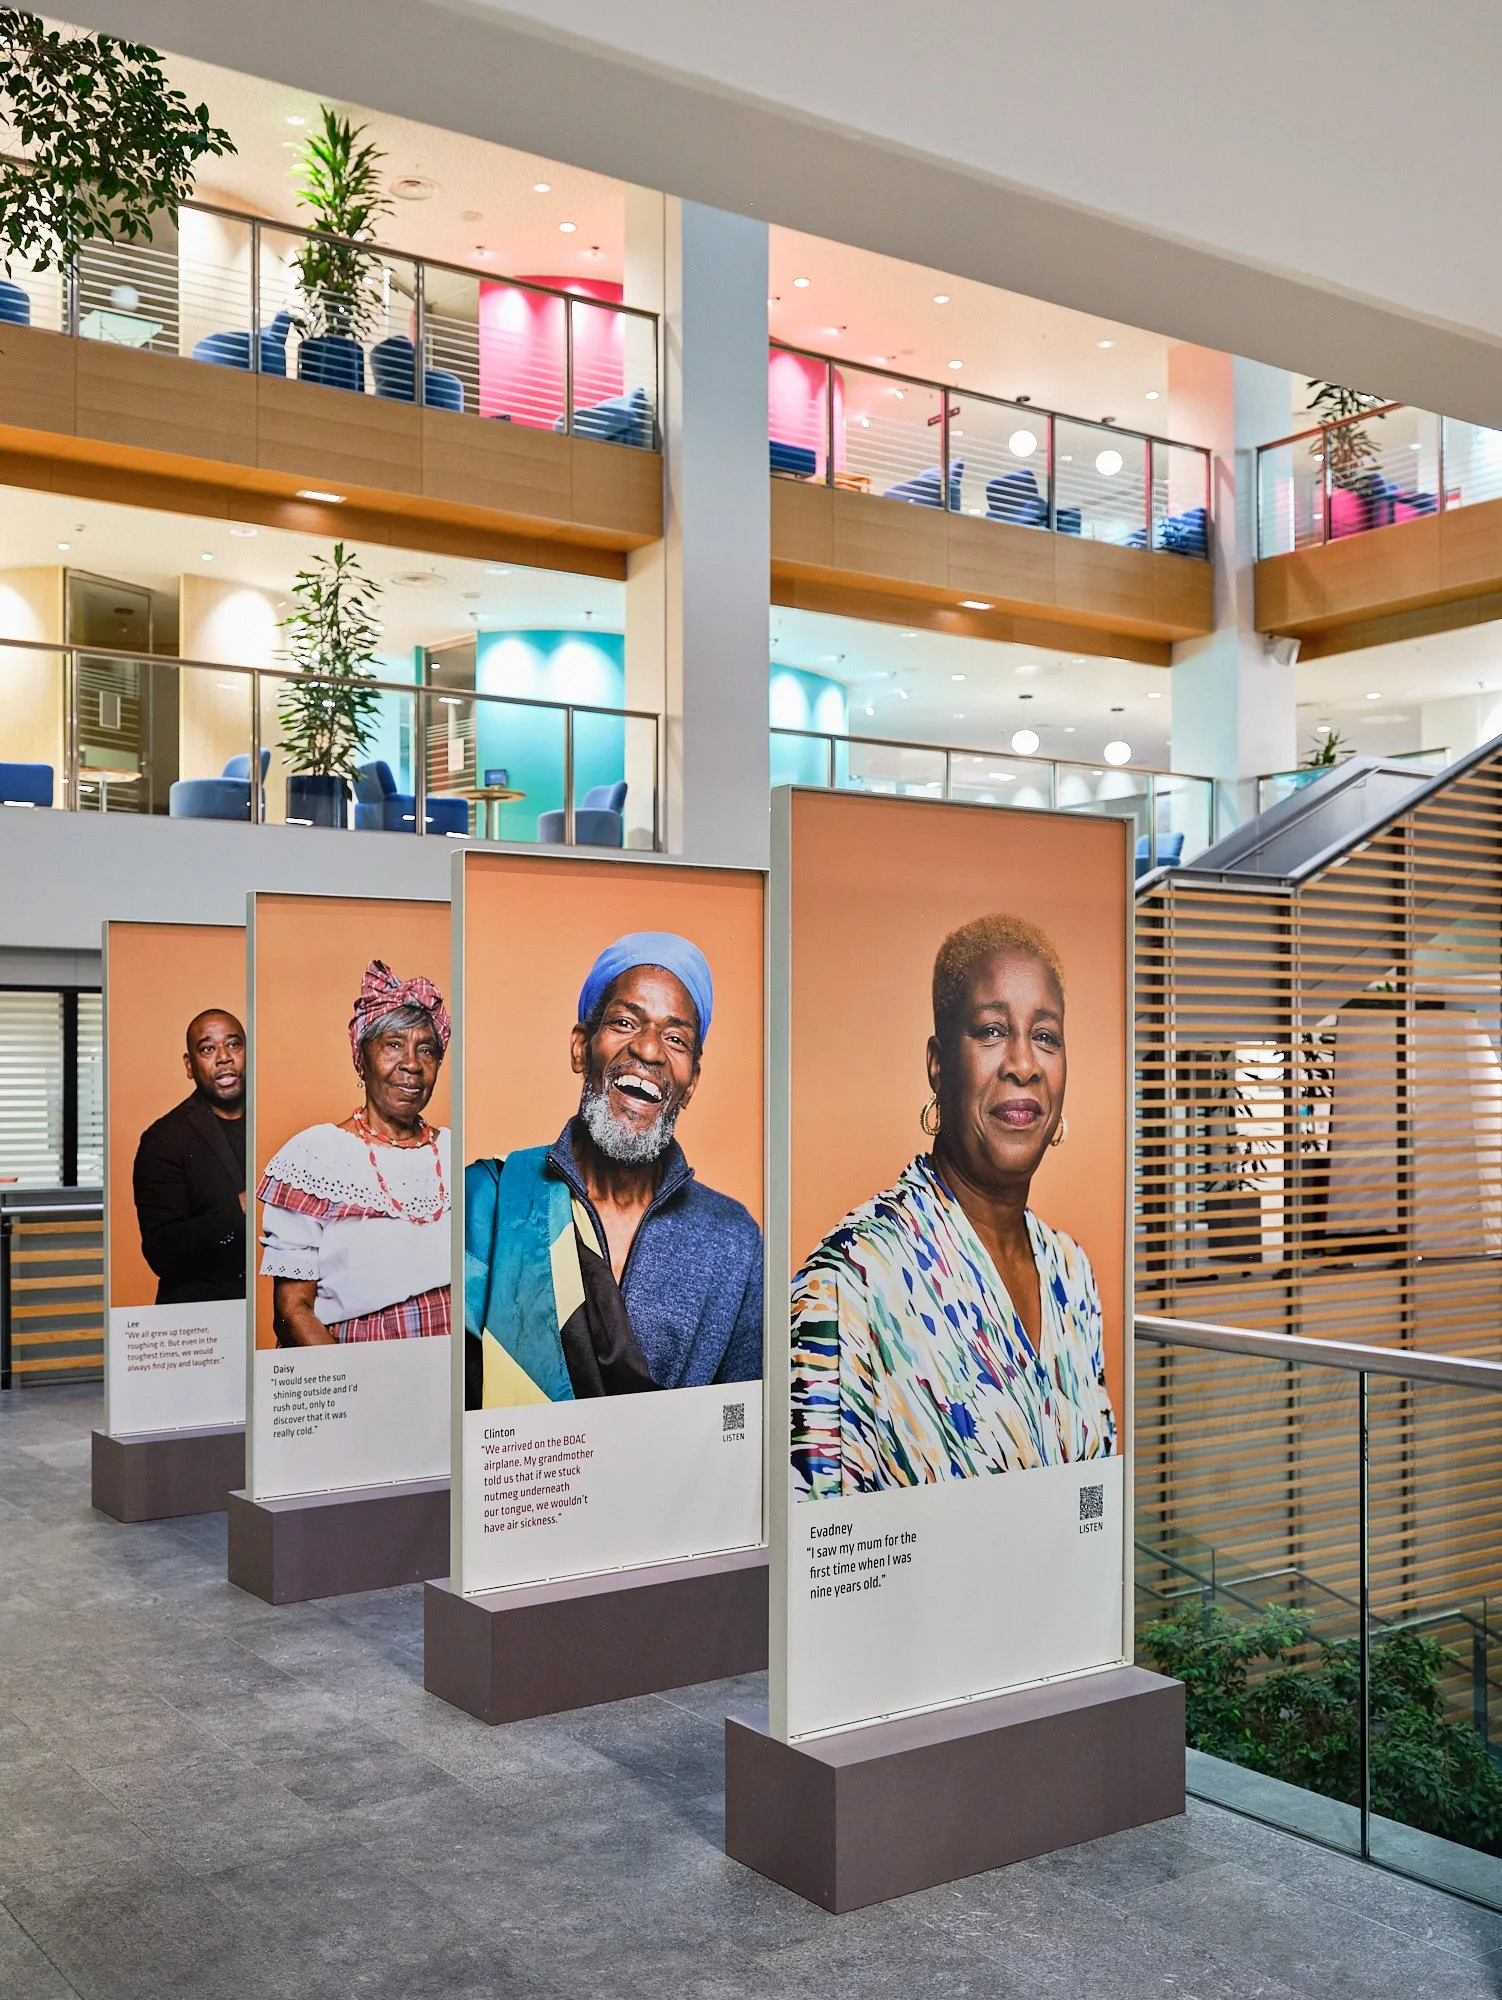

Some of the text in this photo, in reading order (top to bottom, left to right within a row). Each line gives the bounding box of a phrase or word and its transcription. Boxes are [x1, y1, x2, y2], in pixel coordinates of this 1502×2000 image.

[274, 1365, 294, 1374] Daisy
[279, 1377, 302, 1385] would
[274, 1391, 301, 1399] shining
[303, 1387, 331, 1396] outside
[274, 1404, 290, 1412] rush
[310, 1400, 325, 1409] only
[274, 1416, 305, 1425] discover
[307, 1413, 322, 1421] that
[325, 1412, 330, 1420] it
[274, 1428, 294, 1438] really
[484, 1428, 514, 1439] Clinton
[723, 1433, 744, 1442] LISTEN
[481, 1434, 586, 1454] “We arrived on the BOAC
[484, 1449, 593, 1471] airplane. My grandmother
[484, 1466, 580, 1486] told us that if we stuck
[484, 1482, 570, 1502] nutmeg underneath
[484, 1495, 588, 1517] our tongue, we wouldn’t
[484, 1513, 561, 1533] have air sickness.”
[1080, 1522, 1103, 1534] LISTEN
[811, 1524, 852, 1539] Evadney
[806, 1532, 916, 1559] “I saw my mum for the
[810, 1553, 911, 1579] first time when I was
[811, 1574, 886, 1599] nine years old.”
